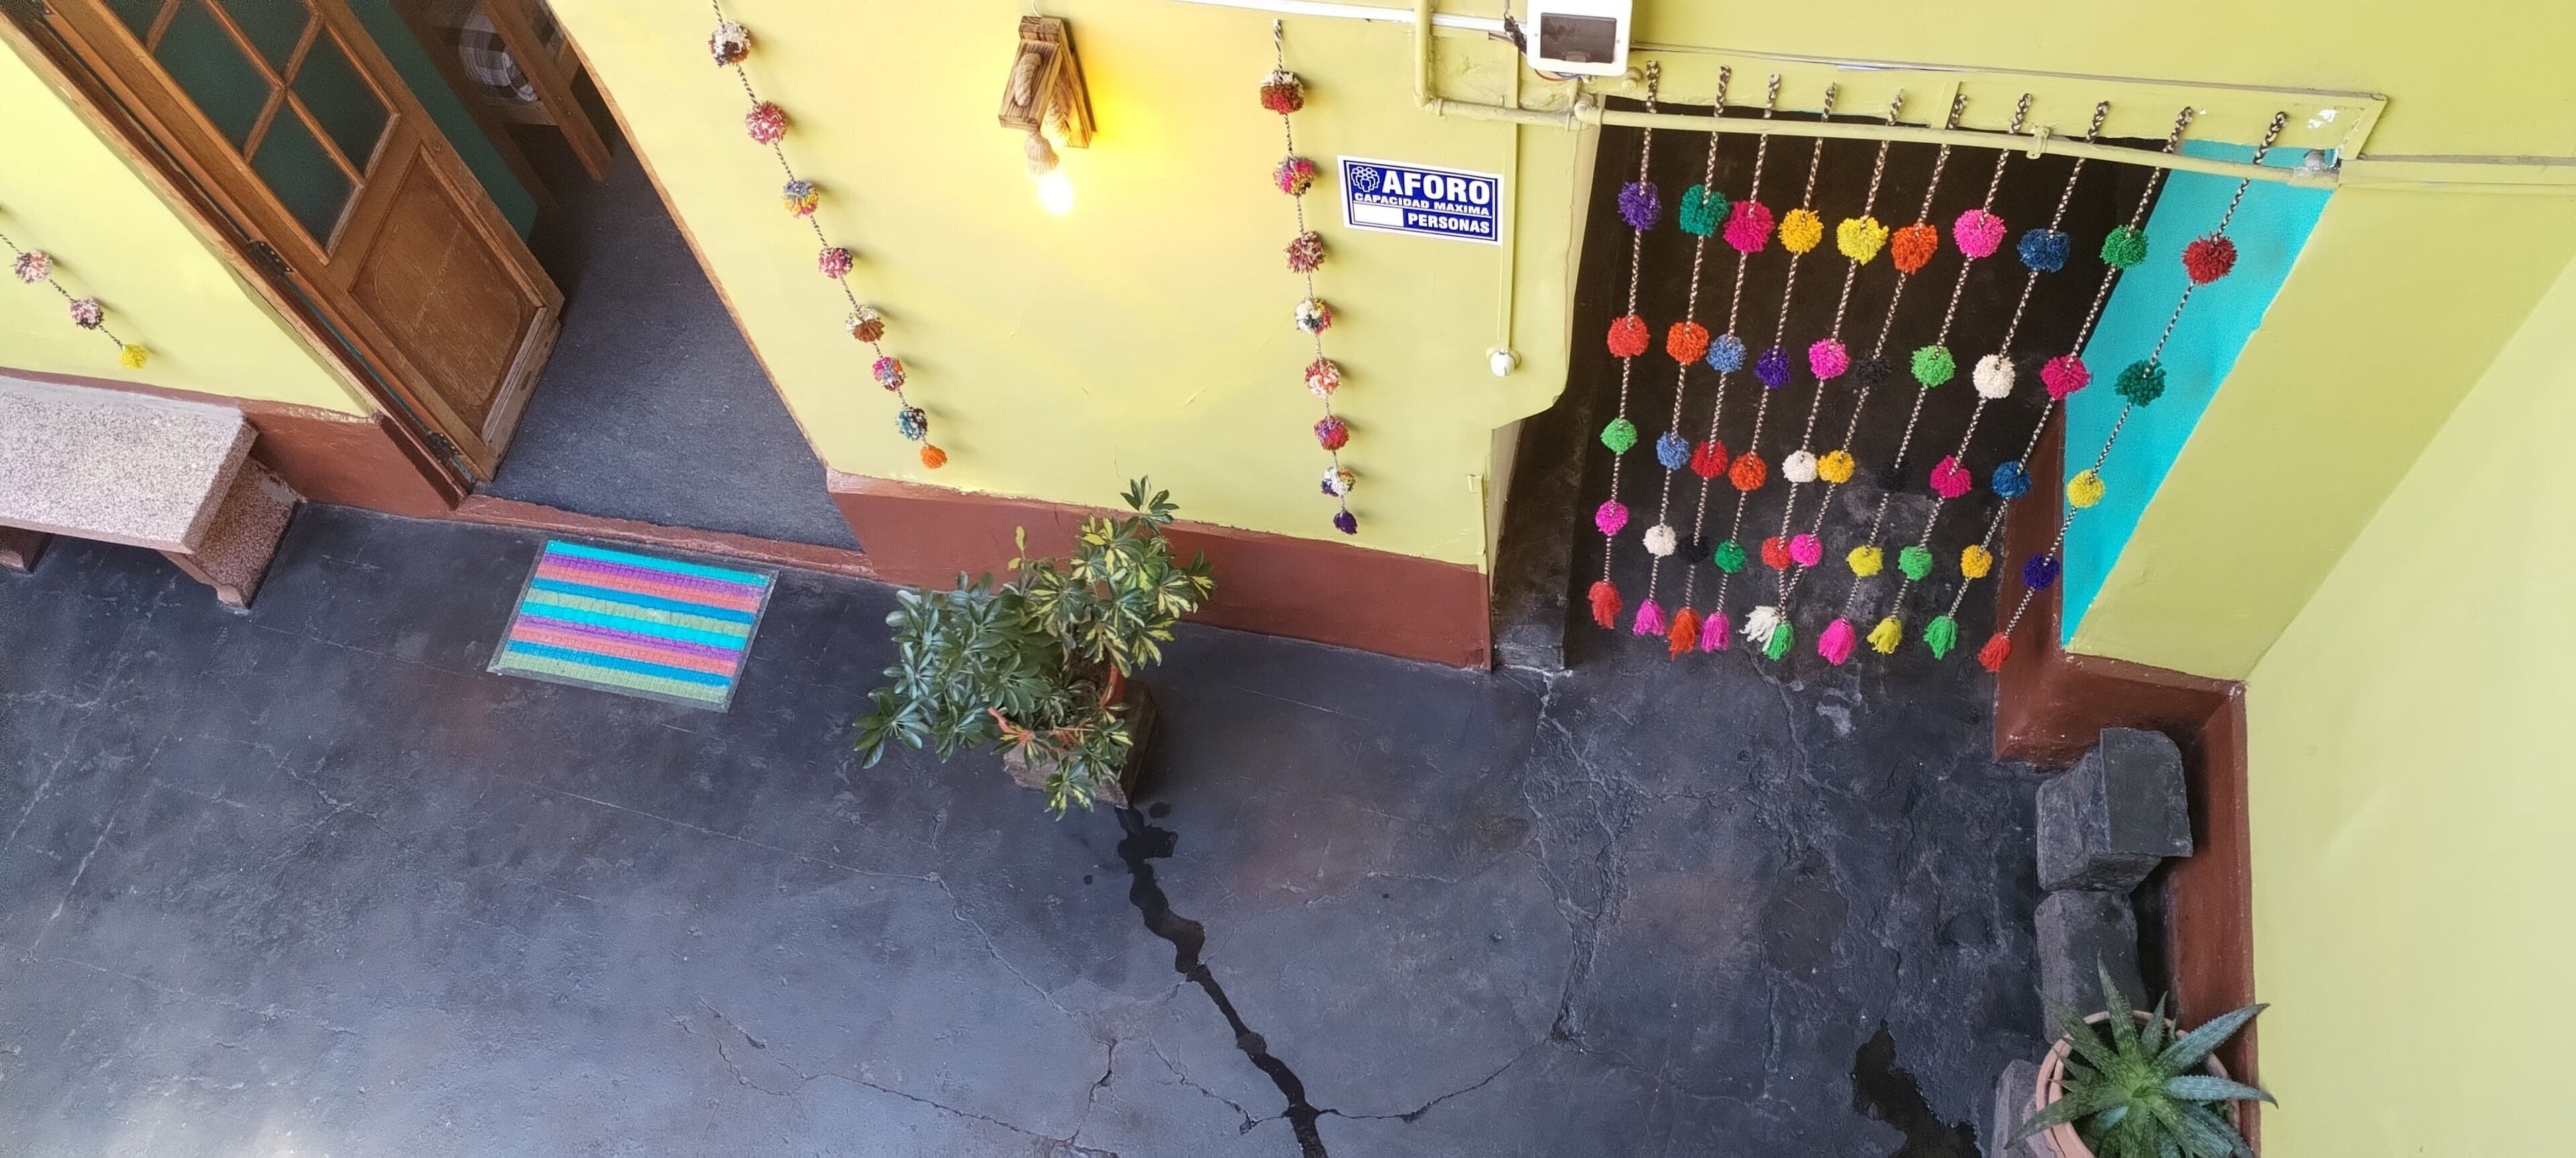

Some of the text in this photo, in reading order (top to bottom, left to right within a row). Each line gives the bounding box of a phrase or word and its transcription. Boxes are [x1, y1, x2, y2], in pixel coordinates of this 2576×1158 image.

[1382, 170, 1490, 205] AFORO
[1354, 193, 1489, 215] CAPACIDAD MAXIMA
[1408, 213, 1490, 233] PERSONAS
